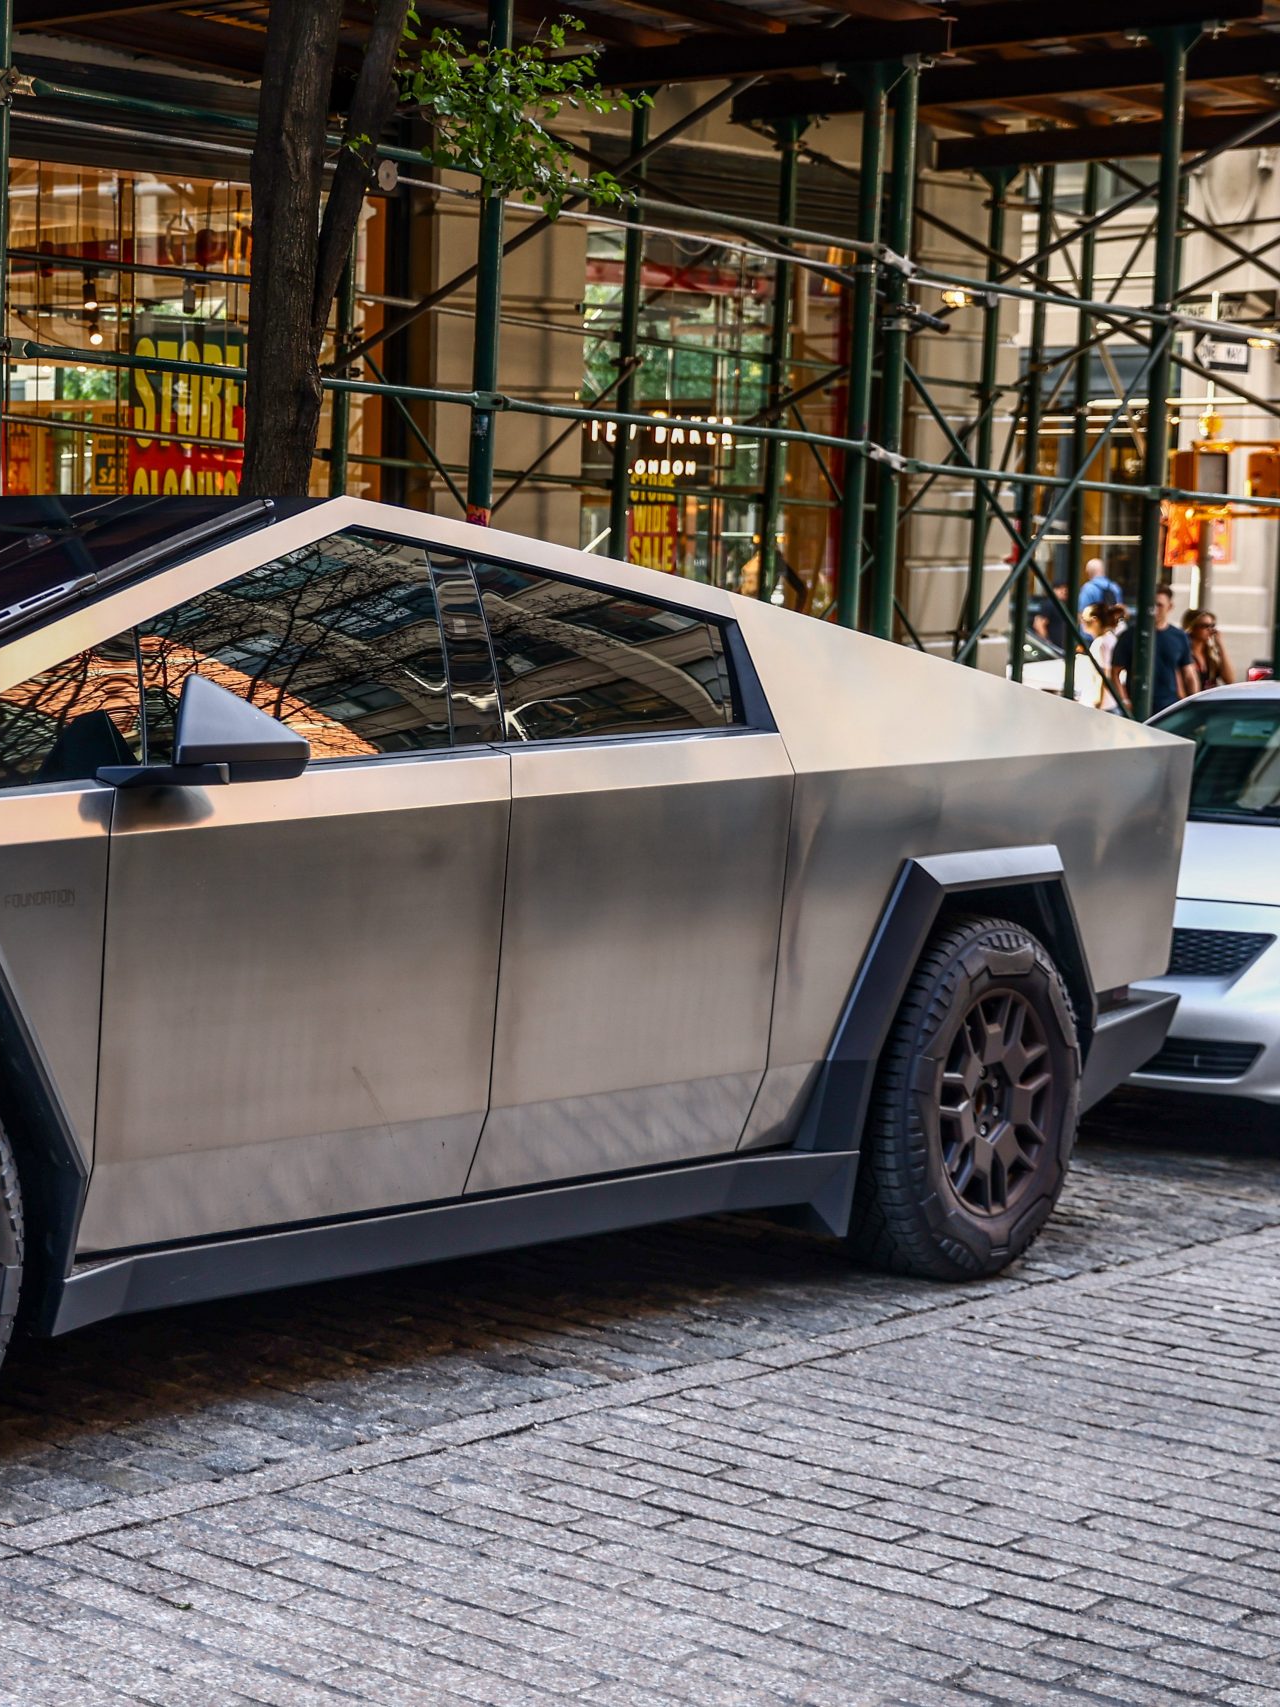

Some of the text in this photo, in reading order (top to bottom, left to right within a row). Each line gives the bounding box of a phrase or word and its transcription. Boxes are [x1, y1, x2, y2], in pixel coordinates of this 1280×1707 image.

[134, 337, 240, 449] STORE
[628, 459, 696, 476] ONDON
[630, 472, 675, 503] STORE
[634, 504, 670, 534] WIDE
[629, 537, 673, 571] SALE
